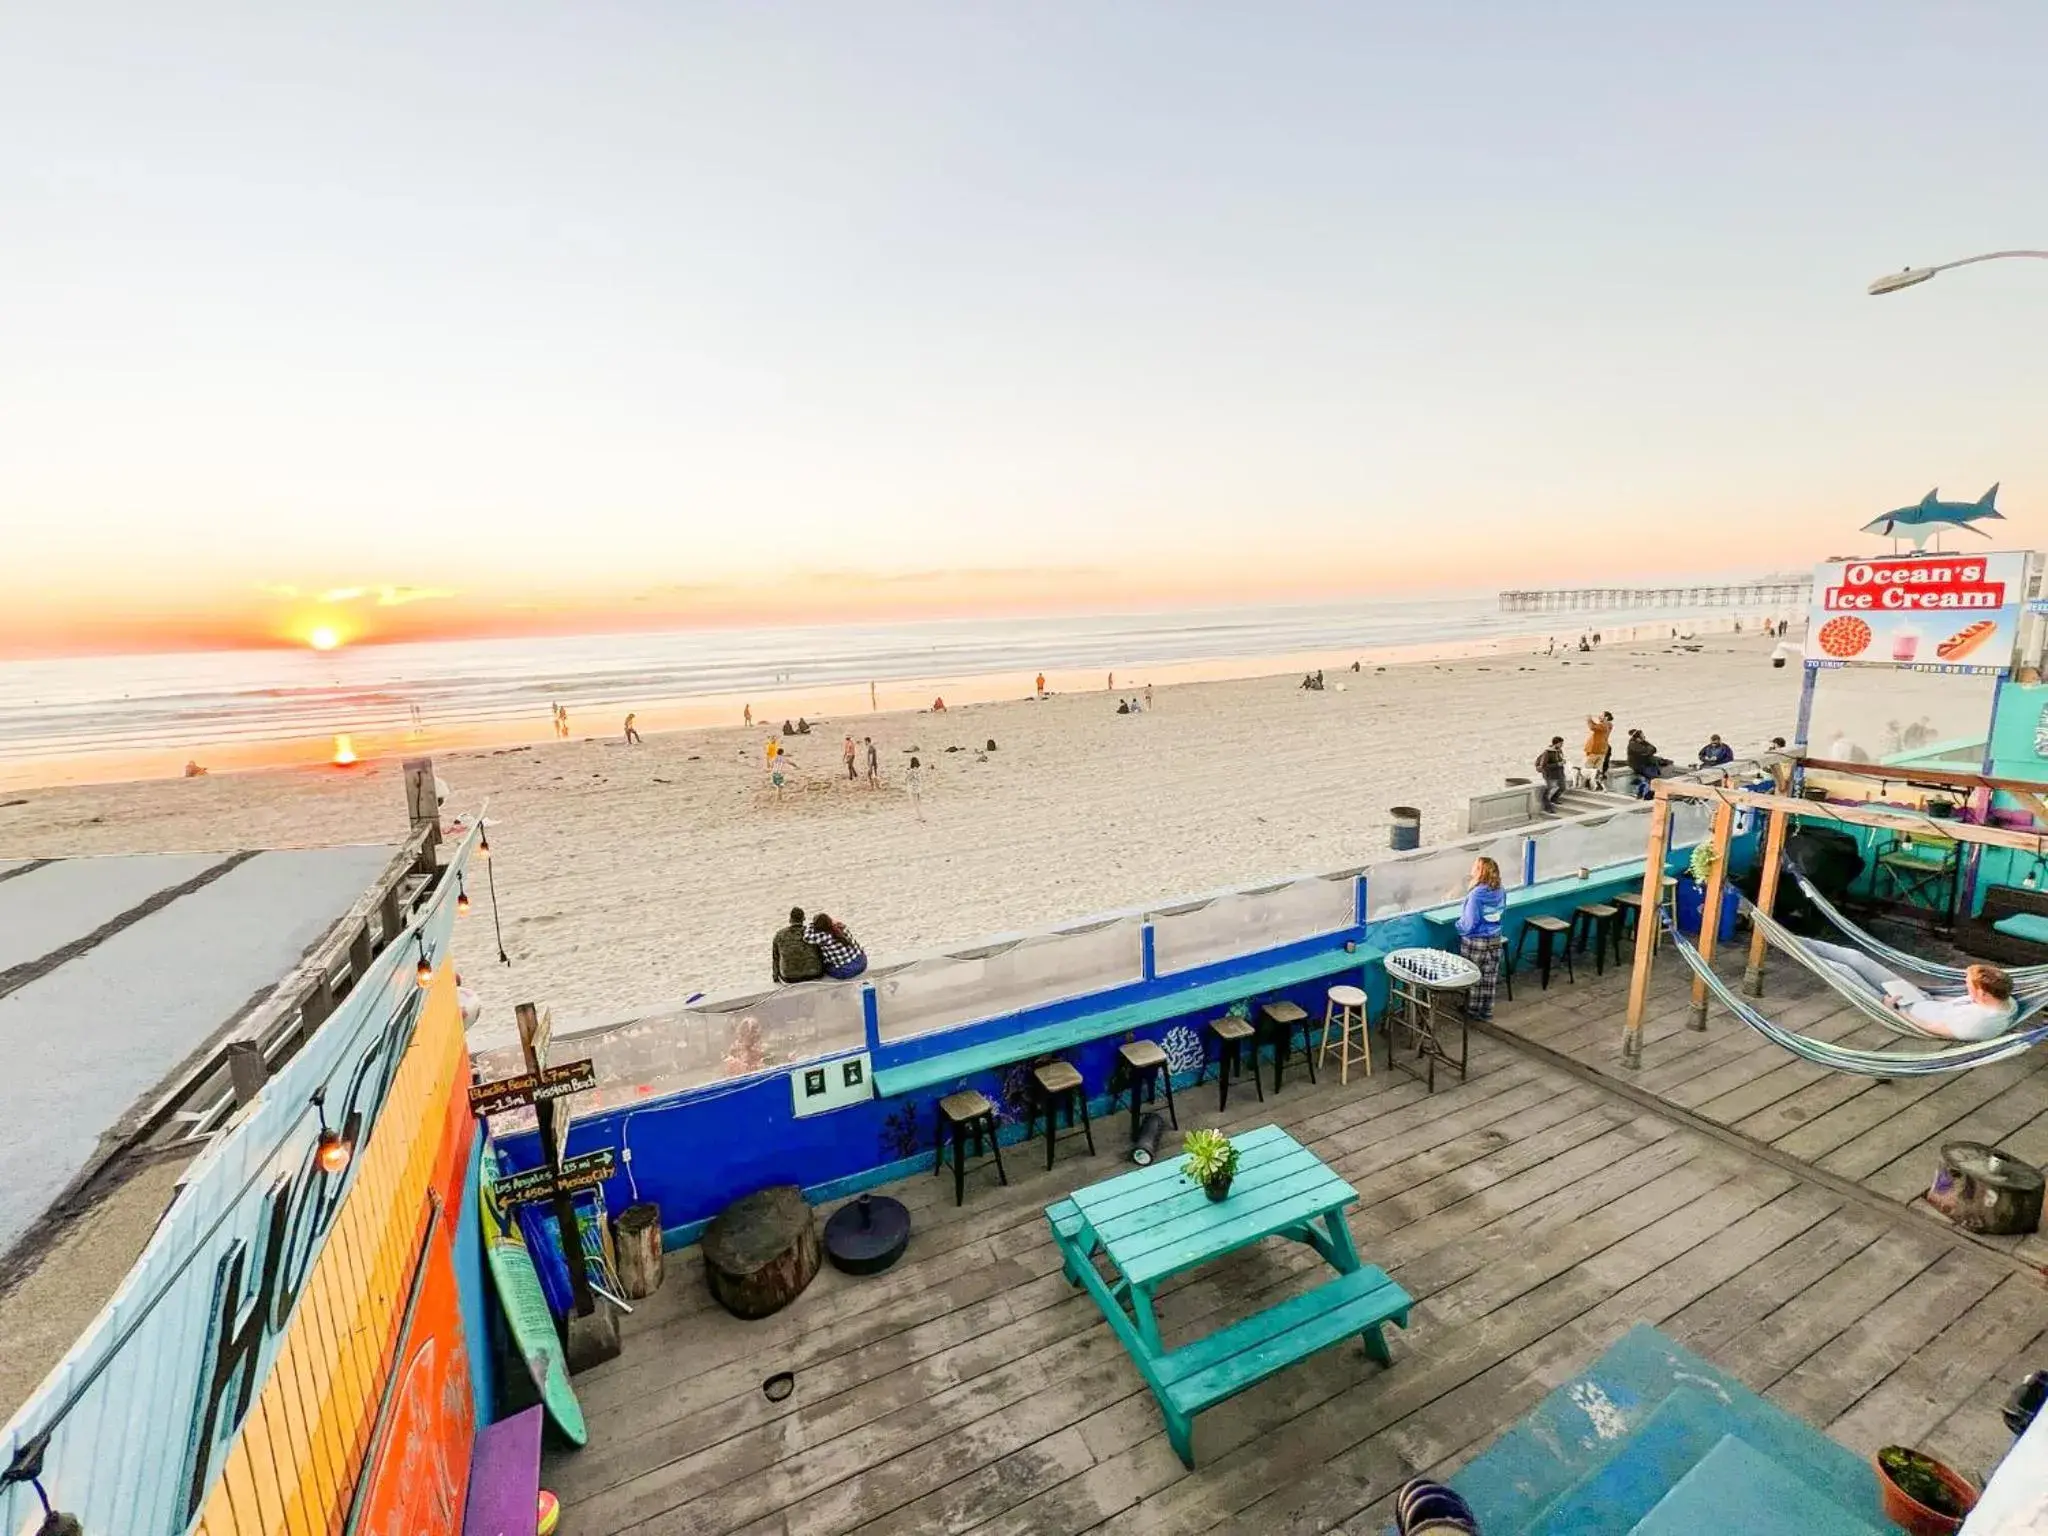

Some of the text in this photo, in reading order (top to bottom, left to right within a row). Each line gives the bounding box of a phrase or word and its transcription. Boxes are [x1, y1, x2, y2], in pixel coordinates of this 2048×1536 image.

[1846, 562, 1982, 586] Ocean's
[1828, 586, 1996, 609] Ice Cream
[533, 1083, 572, 1100] Mission
[571, 1074, 597, 1092] Beach
[495, 1181, 512, 1195] Los
[513, 1171, 553, 1189] Angeles
[558, 1172, 593, 1188] Mexico
[592, 1163, 616, 1177] City
